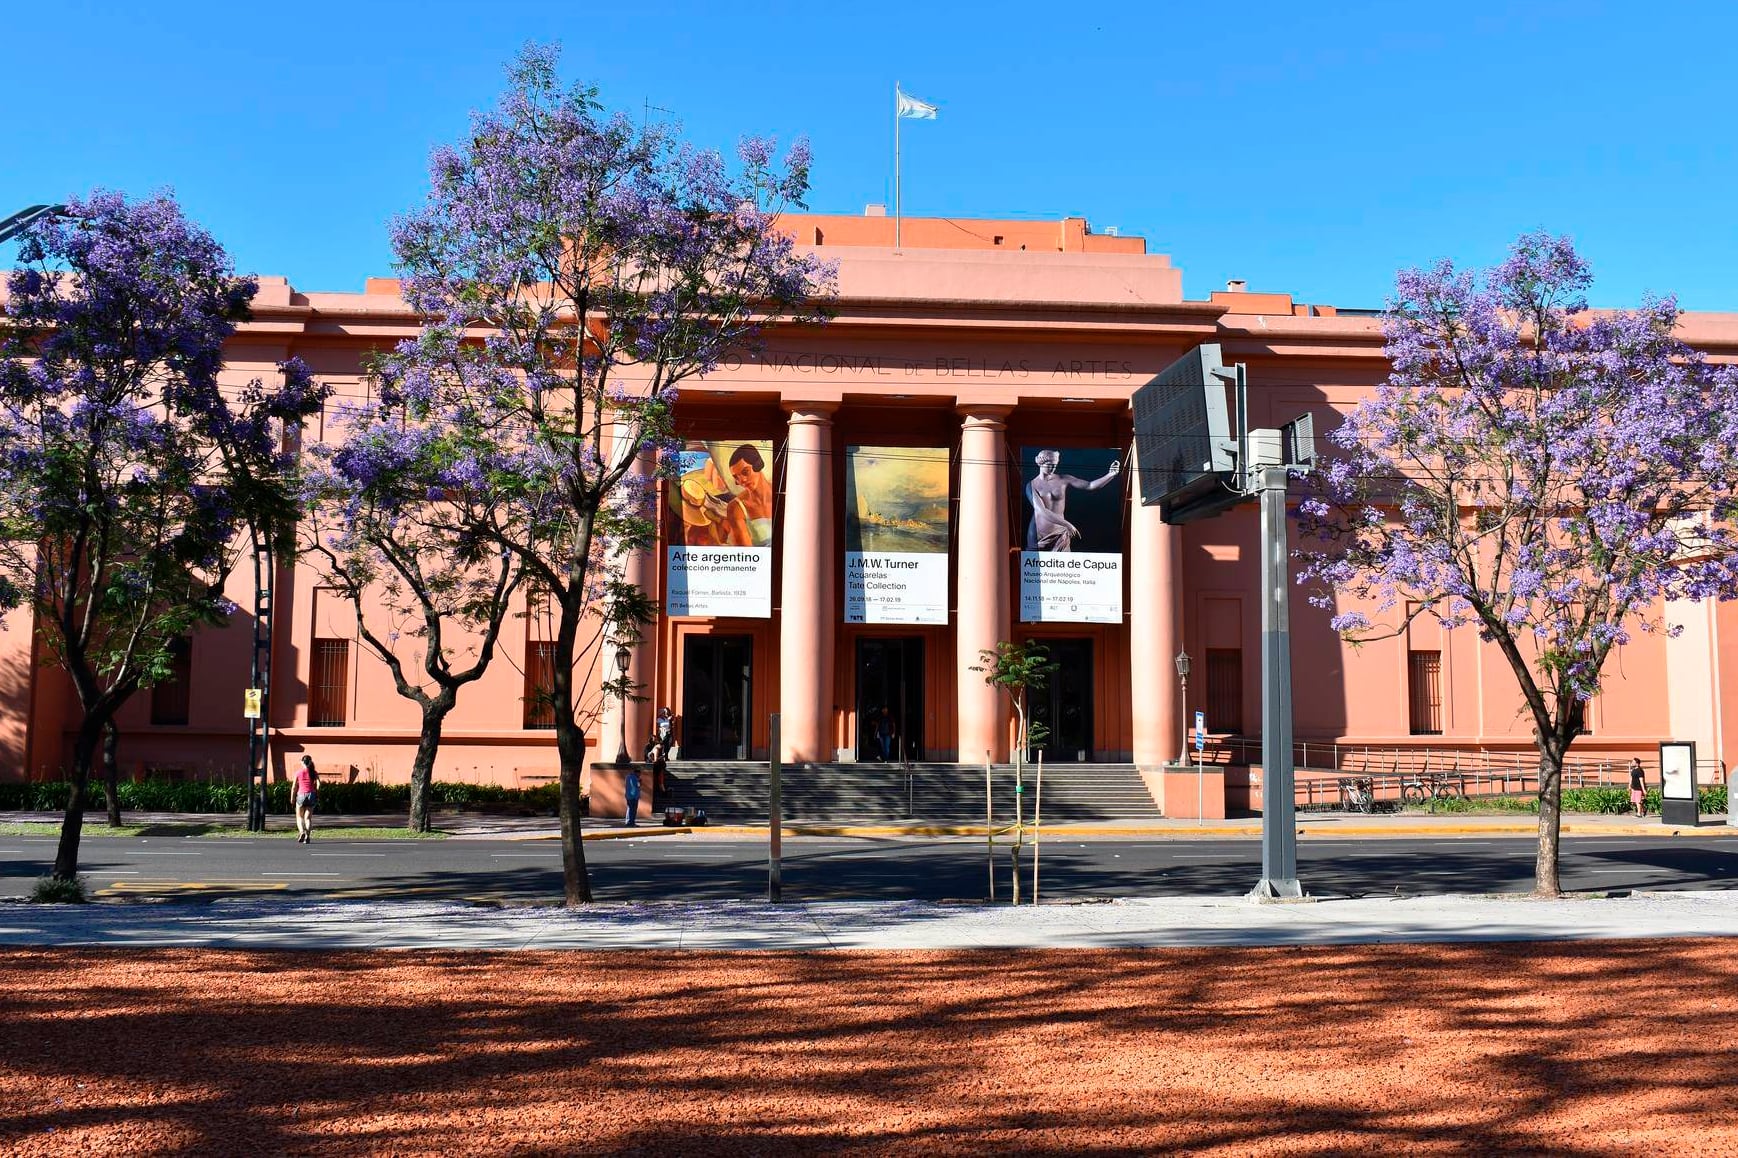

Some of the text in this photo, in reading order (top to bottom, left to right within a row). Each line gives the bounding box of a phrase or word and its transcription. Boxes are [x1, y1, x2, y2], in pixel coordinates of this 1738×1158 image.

[760, 353, 892, 376] NACIONAL
[904, 362, 924, 376] DE
[935, 357, 1029, 378] BELLAS
[1051, 360, 1132, 379] ARTES
[672, 552, 760, 564] Arte argentino
[672, 563, 757, 573] colección permanente
[848, 558, 919, 569] J.M.W. Turner
[1024, 558, 1117, 571] Afrodita de Capua
[848, 571, 888, 579] Acuarelas
[1043, 571, 1081, 579] Arqueológico
[848, 582, 907, 590] Tate Collection
